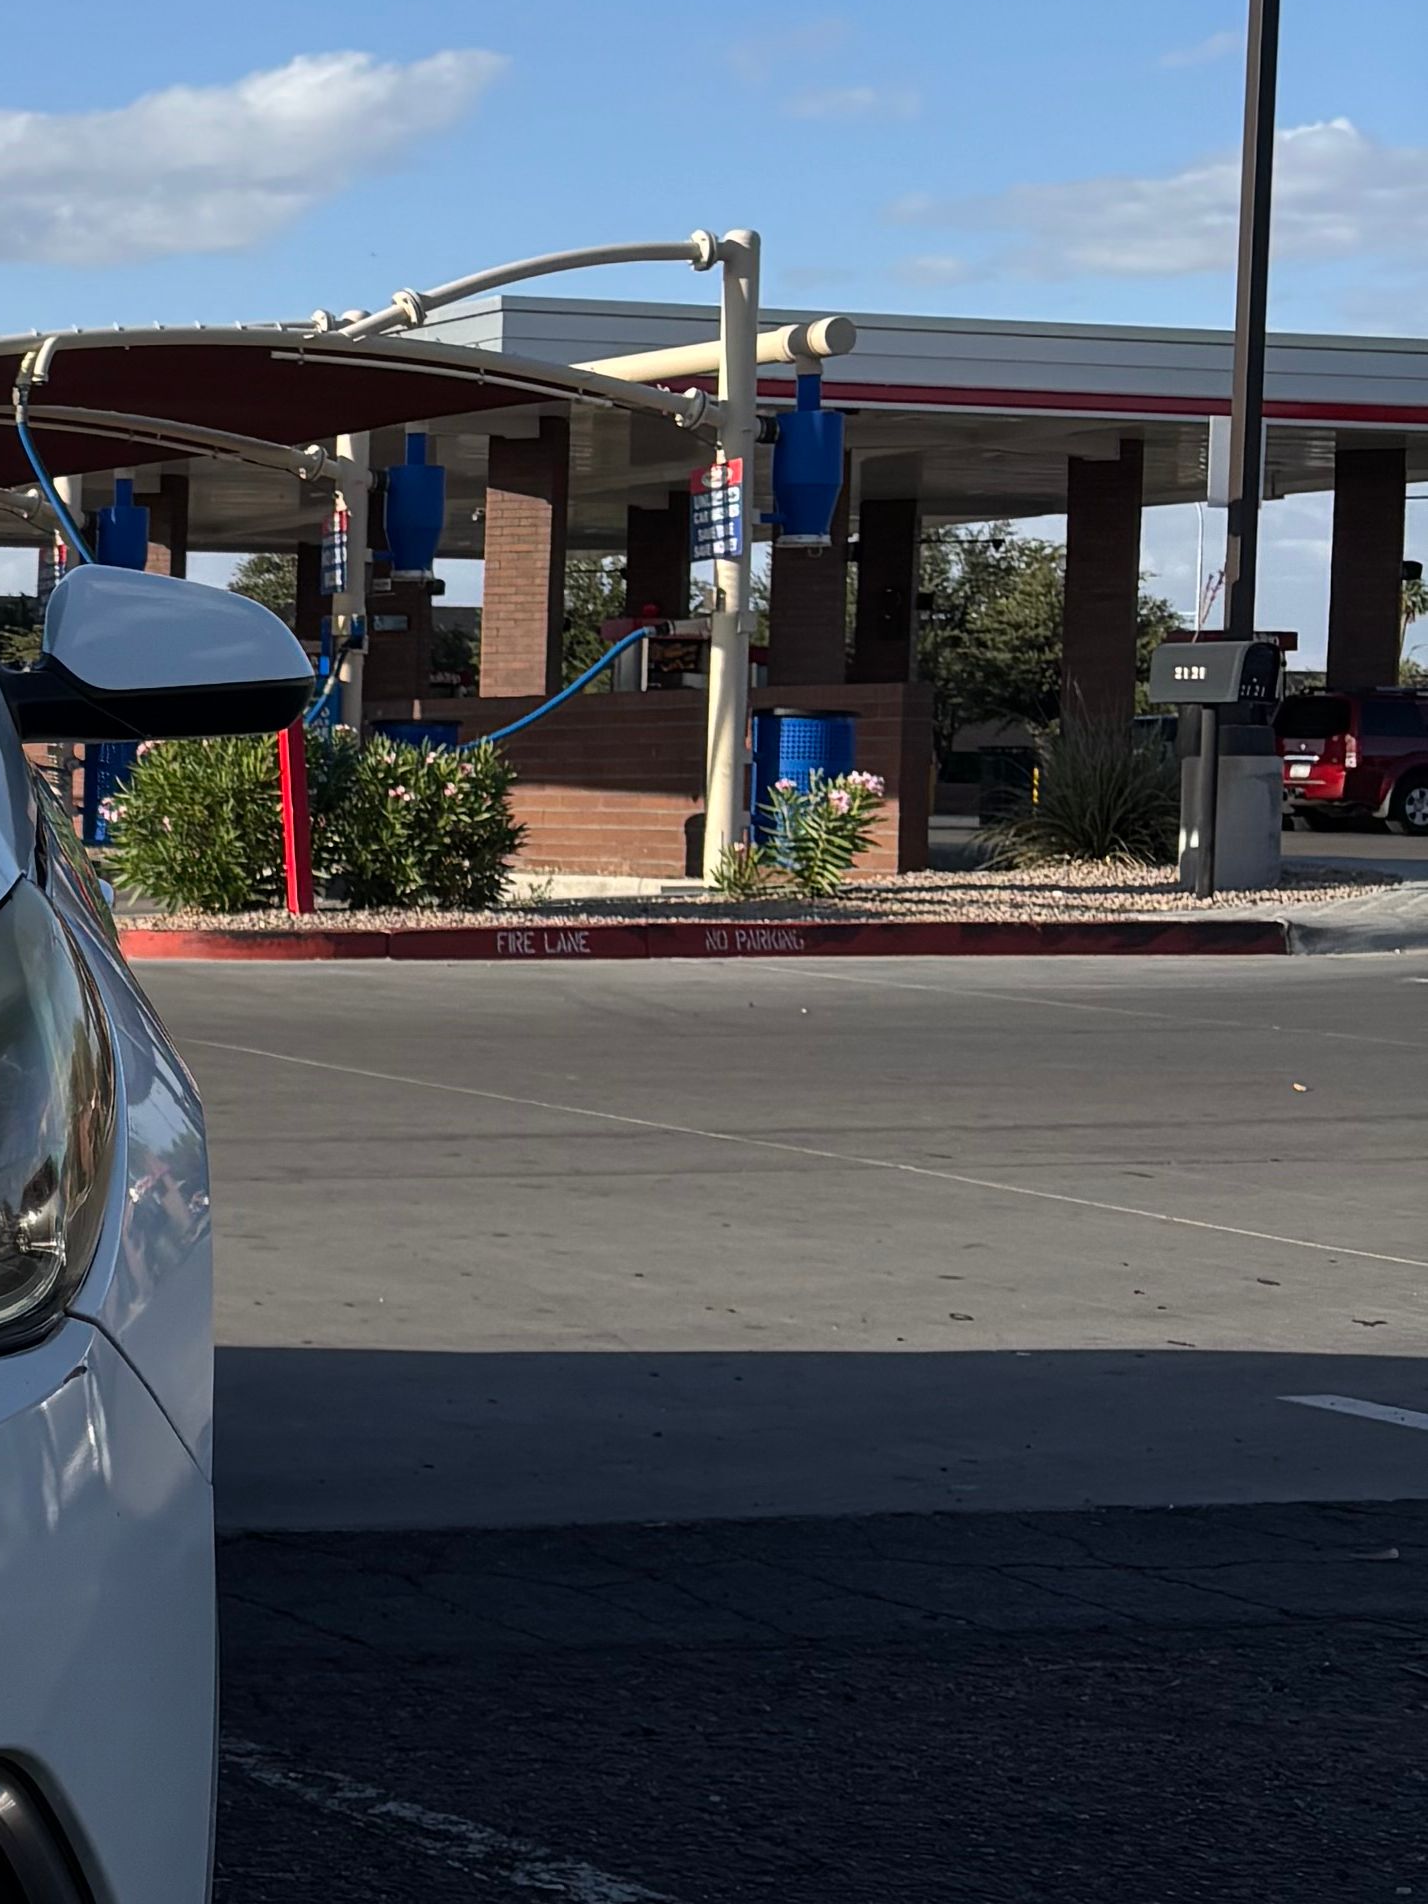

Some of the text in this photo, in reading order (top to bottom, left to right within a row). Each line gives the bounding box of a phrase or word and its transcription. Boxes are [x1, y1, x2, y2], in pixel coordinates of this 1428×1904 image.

[497, 931, 591, 954] FIRE LANE
[705, 928, 804, 951] NO PARKING
